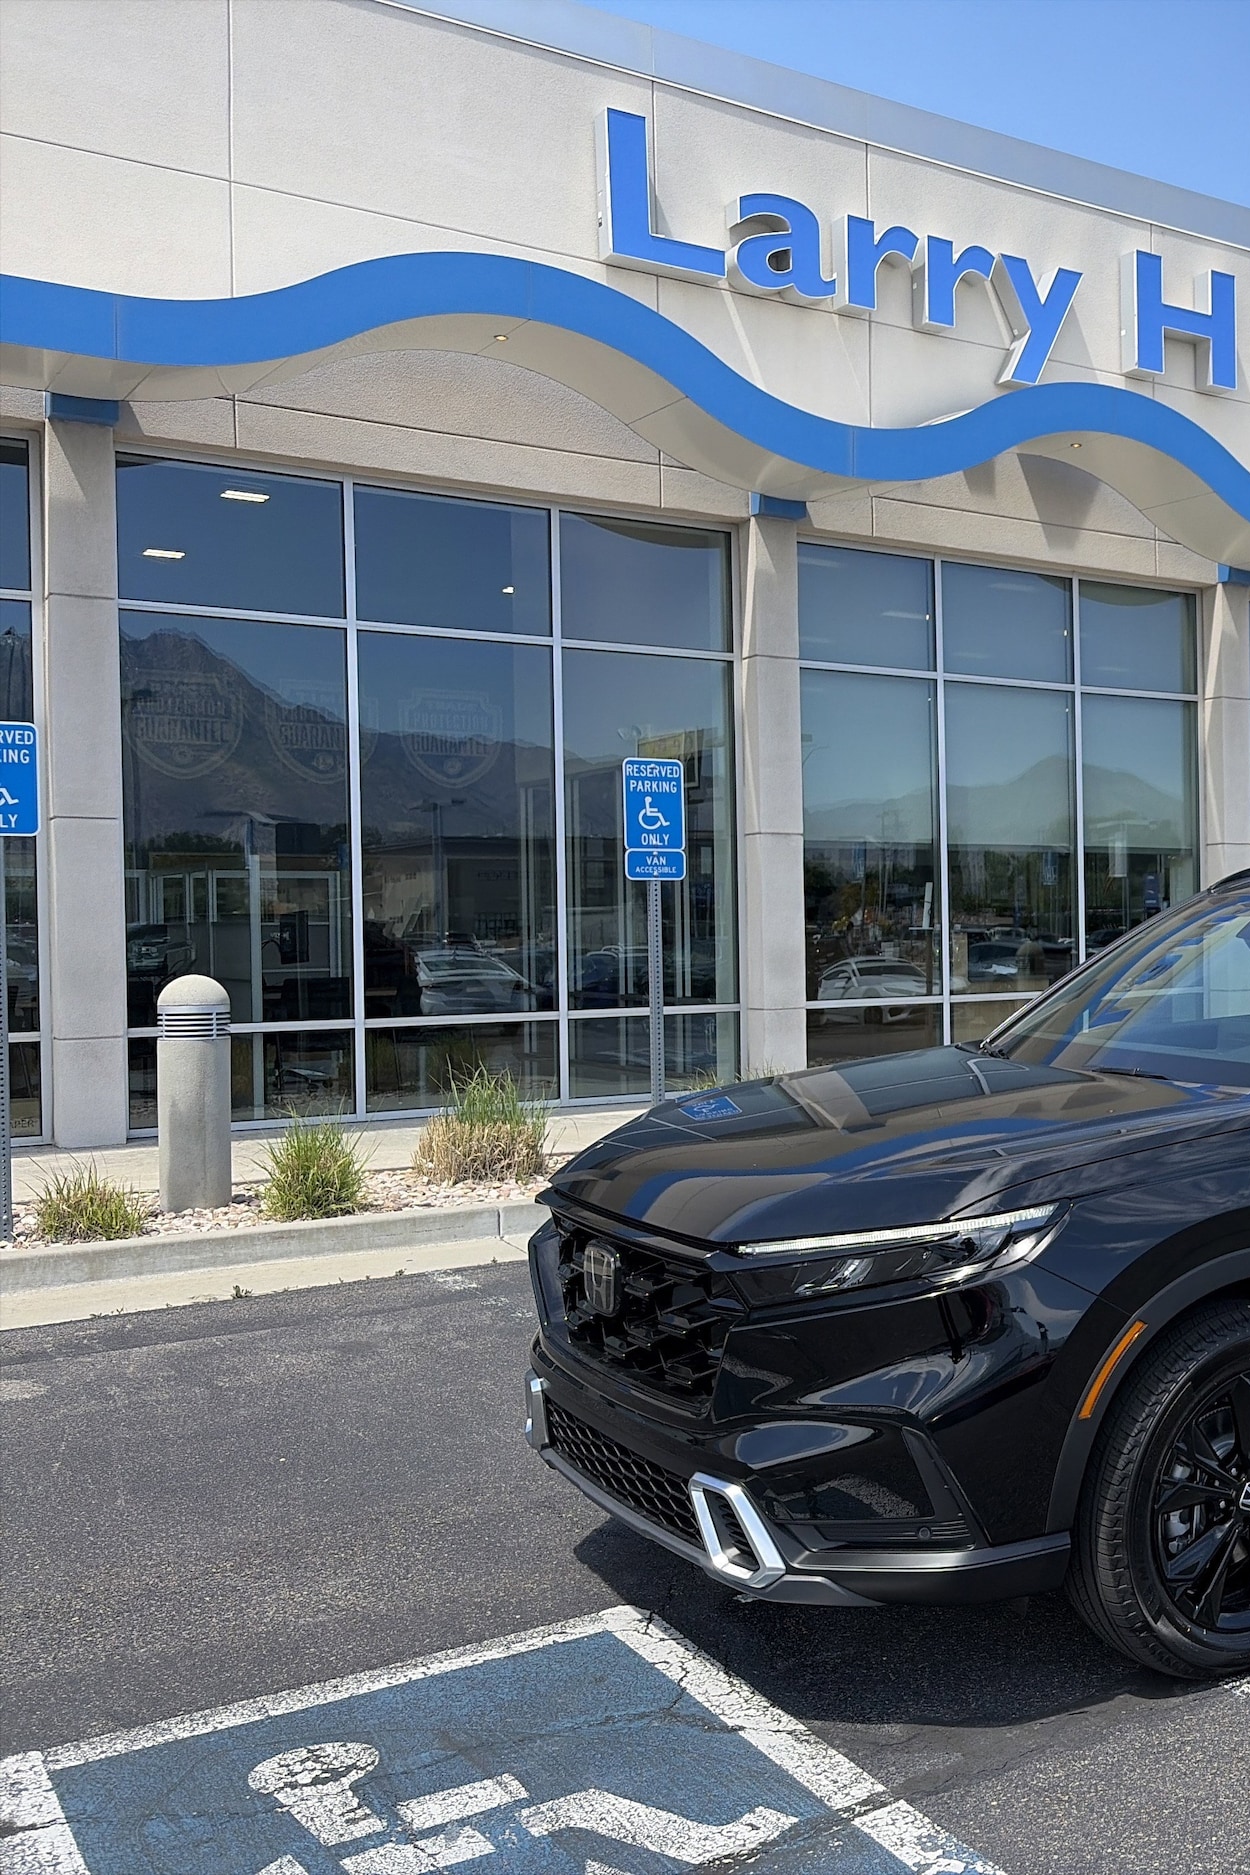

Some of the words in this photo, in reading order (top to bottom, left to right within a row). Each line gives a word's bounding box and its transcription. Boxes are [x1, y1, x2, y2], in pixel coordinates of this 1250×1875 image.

[602, 107, 1083, 386] Larry
[1132, 249, 1238, 391] H
[0, 749, 30, 764] ING
[626, 763, 680, 778] RESERVED
[629, 780, 677, 793] PARKING
[641, 833, 670, 846] ONLY
[645, 856, 666, 866] VAN
[635, 866, 677, 874] ACCESSIBLE
